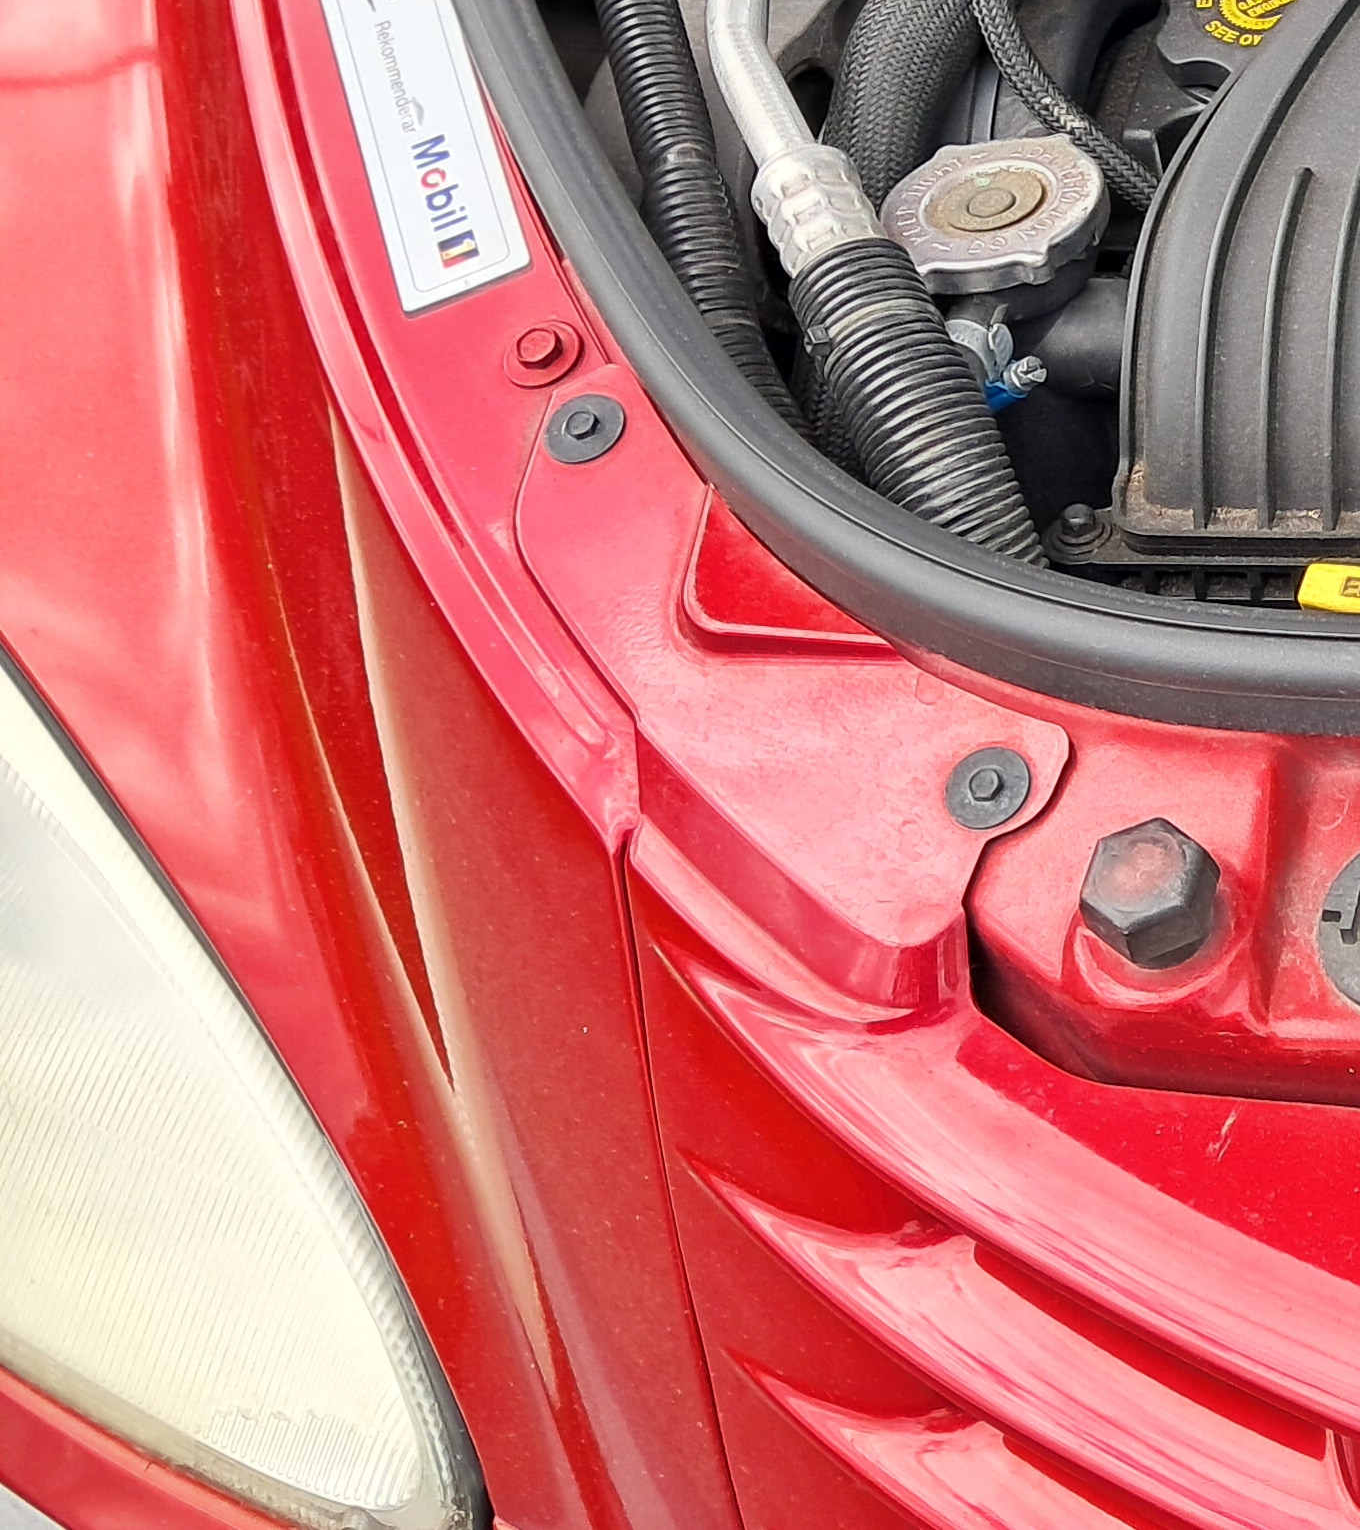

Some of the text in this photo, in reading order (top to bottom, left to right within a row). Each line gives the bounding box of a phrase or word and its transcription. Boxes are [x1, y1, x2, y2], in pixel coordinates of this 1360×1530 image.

[374, 20, 417, 134] Rekommenderar
[1204, 20, 1241, 44] SEE
[410, 134, 470, 232] Mobil
